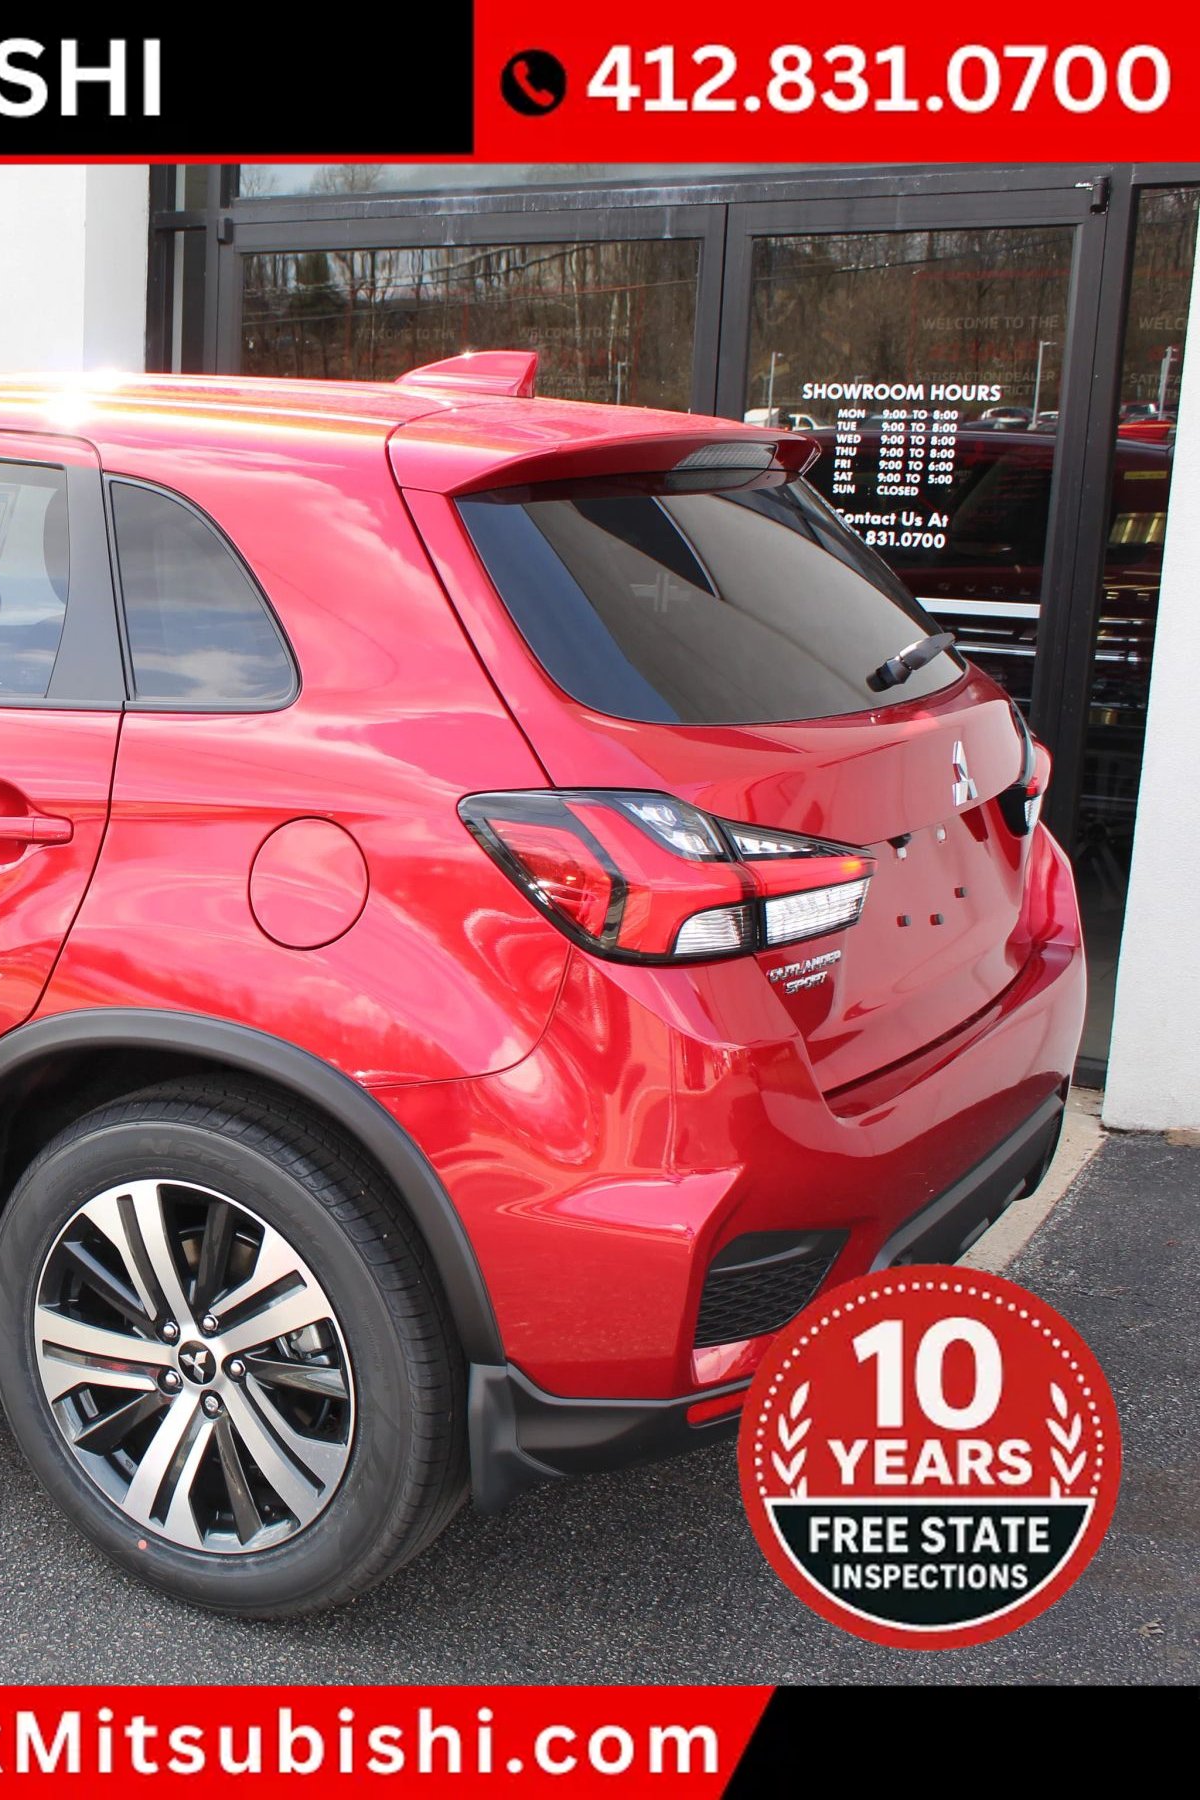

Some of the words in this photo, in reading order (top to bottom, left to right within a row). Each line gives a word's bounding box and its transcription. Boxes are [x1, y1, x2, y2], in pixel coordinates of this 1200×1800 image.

[802, 383, 924, 401] SHOWROOM
[930, 384, 1001, 401] HOURS
[837, 409, 866, 419] MON
[882, 409, 907, 420] 9:00
[912, 409, 928, 420] TO
[933, 410, 958, 421] 8:00
[836, 421, 857, 431] TUE
[881, 422, 905, 433] 9:00
[910, 422, 926, 433] TO
[932, 422, 958, 433] 8:00
[836, 434, 862, 444] WED
[880, 434, 905, 445] 9:00
[909, 435, 925, 445] TO
[930, 435, 956, 446] 8:00
[835, 446, 857, 457] THU
[879, 447, 904, 458] 9:00
[908, 447, 925, 458] TO
[929, 448, 955, 459] 8:00
[834, 459, 851, 469] FRI
[878, 460, 903, 471] 9:00
[907, 460, 923, 471] TO
[927, 461, 953, 472] 6:00
[833, 471, 853, 481] SAT
[877, 472, 901, 483] 9:00
[905, 473, 921, 484] TO
[927, 474, 953, 485] 5:00
[832, 484, 856, 494] SUN
[876, 485, 919, 496] CLOSED
[901, 511, 923, 527] Us
[928, 512, 949, 528] At
[784, 970, 828, 994] SPORT
